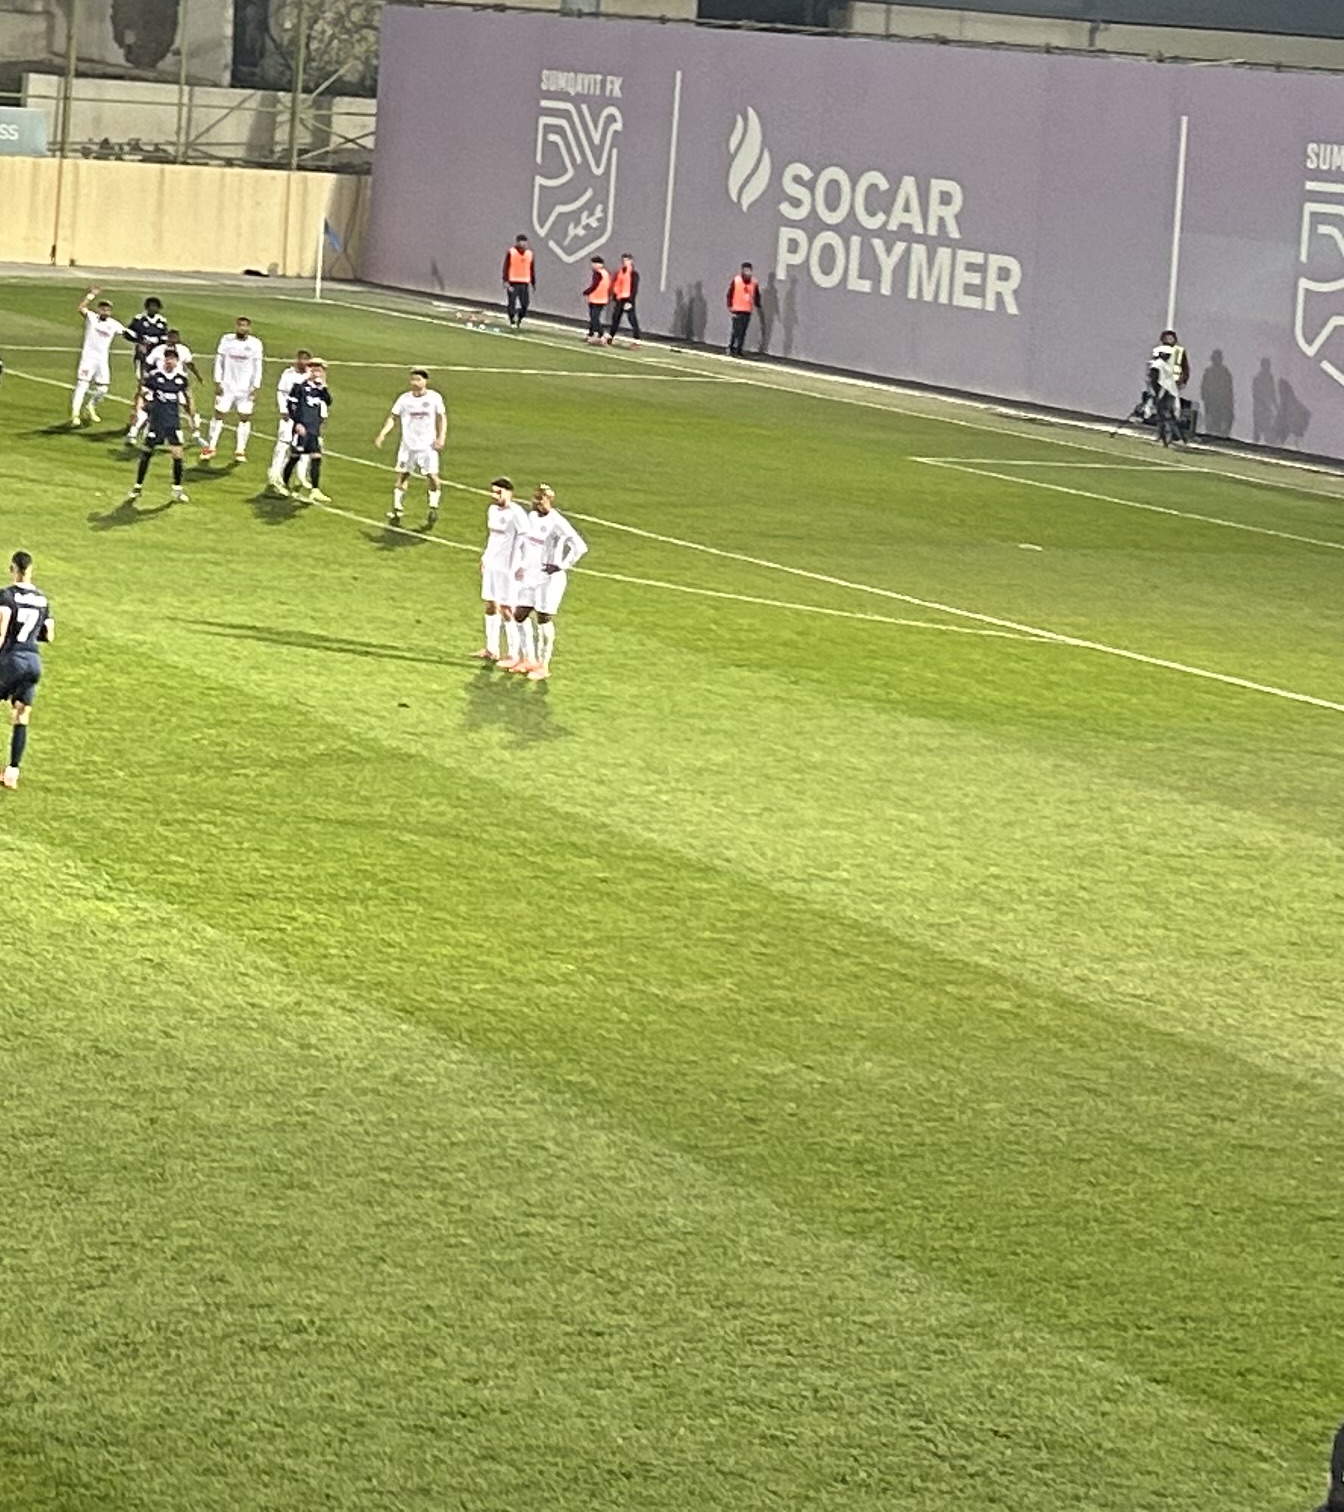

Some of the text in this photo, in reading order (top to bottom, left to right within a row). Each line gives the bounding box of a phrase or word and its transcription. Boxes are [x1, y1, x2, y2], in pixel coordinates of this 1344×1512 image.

[605, 75, 624, 98] FK
[778, 162, 963, 239] SOCAR
[775, 226, 1023, 316] POLYMER
[16, 607, 40, 643] 7
